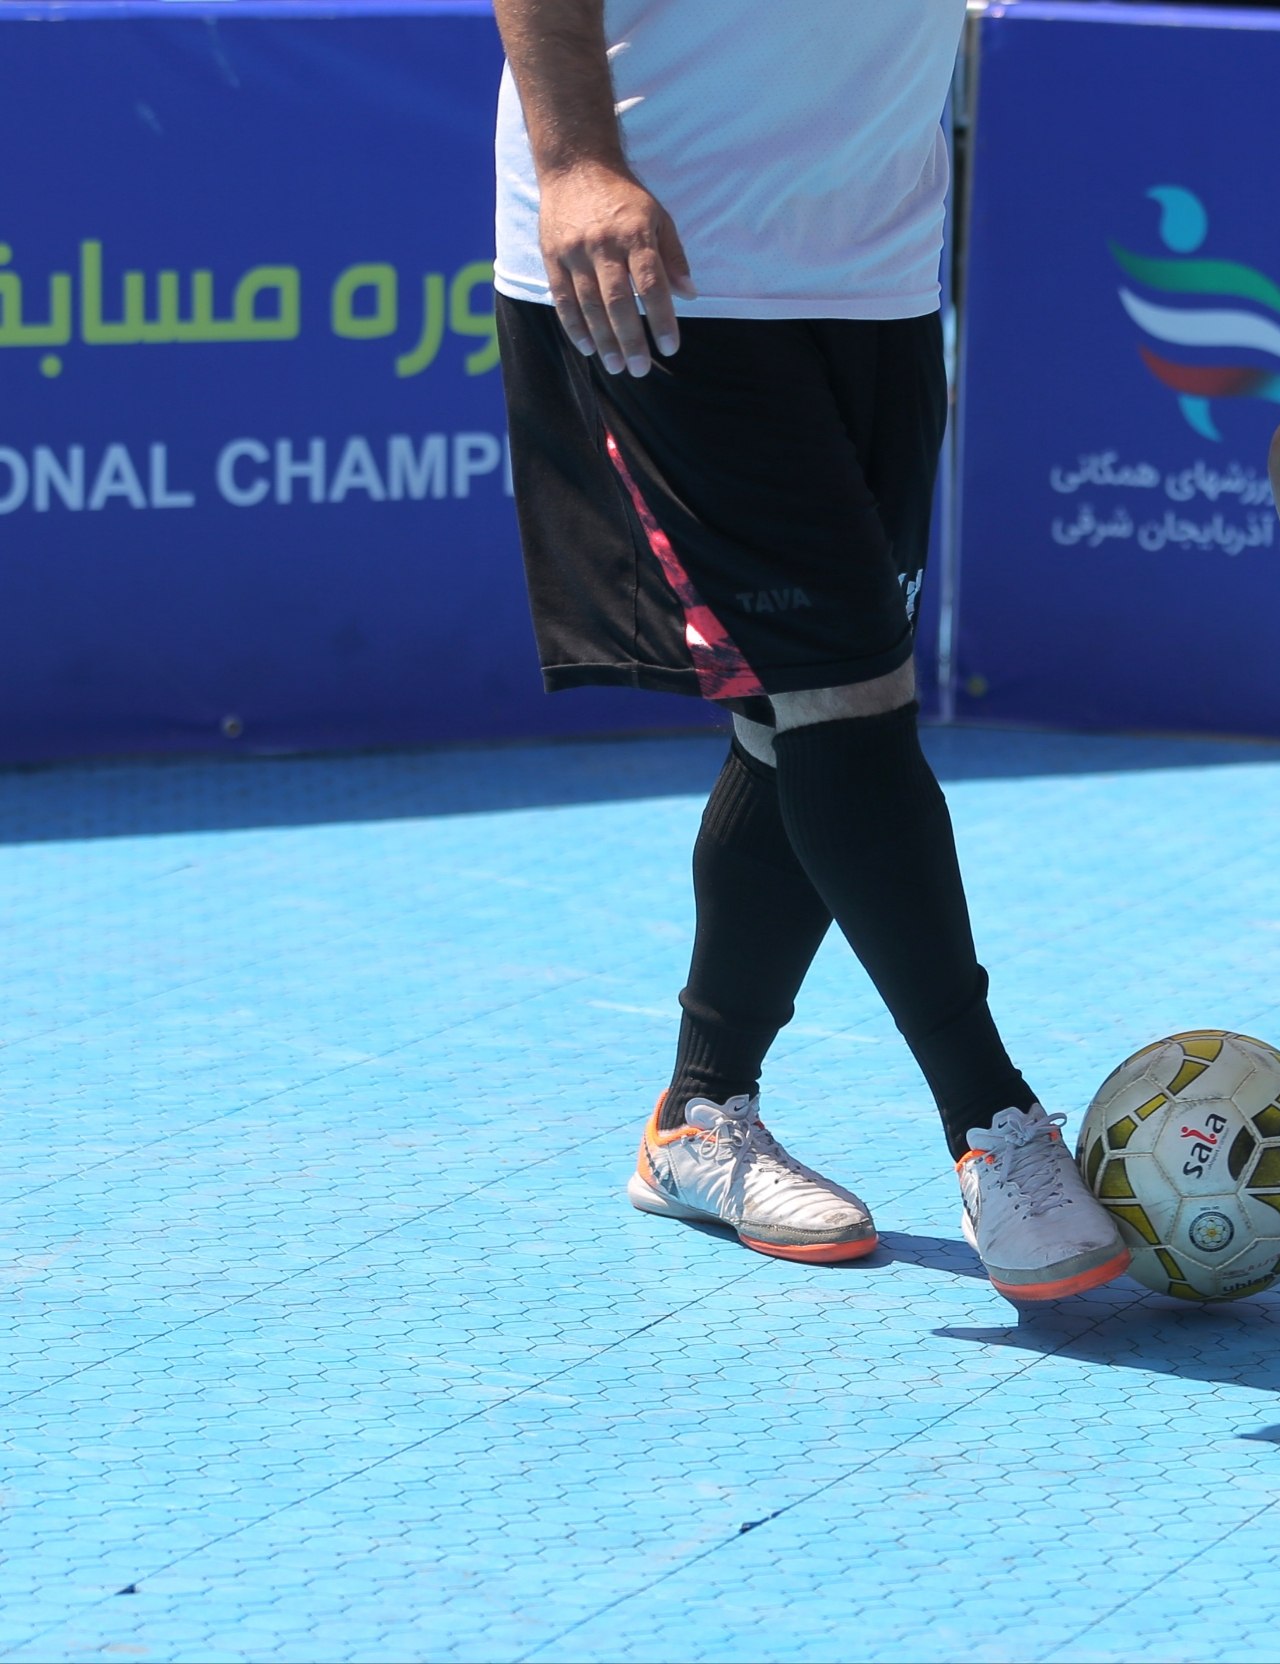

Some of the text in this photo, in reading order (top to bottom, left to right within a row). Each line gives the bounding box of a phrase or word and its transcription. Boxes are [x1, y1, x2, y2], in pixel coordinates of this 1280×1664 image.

[1051, 502, 1134, 547] شرقی
[735, 587, 813, 613] TAVA
[1180, 1113, 1228, 1179] sala
